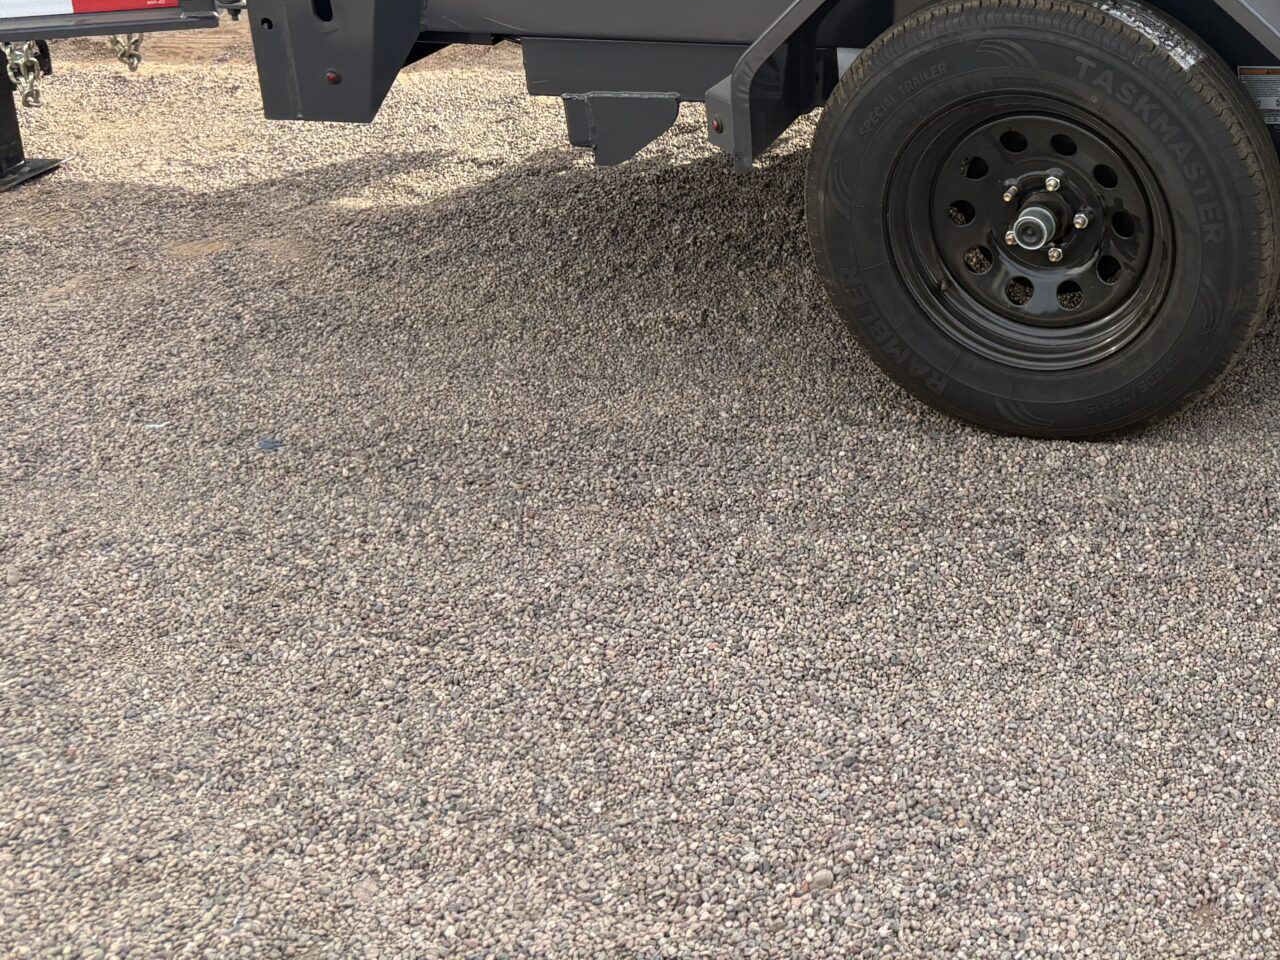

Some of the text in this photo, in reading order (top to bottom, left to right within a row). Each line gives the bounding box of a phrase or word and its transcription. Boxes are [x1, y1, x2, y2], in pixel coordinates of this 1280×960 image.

[859, 63, 948, 138] SPECIAL TRAILER
[1075, 55, 1225, 244] TASKMASTER
[839, 266, 950, 397] RAMBLER
